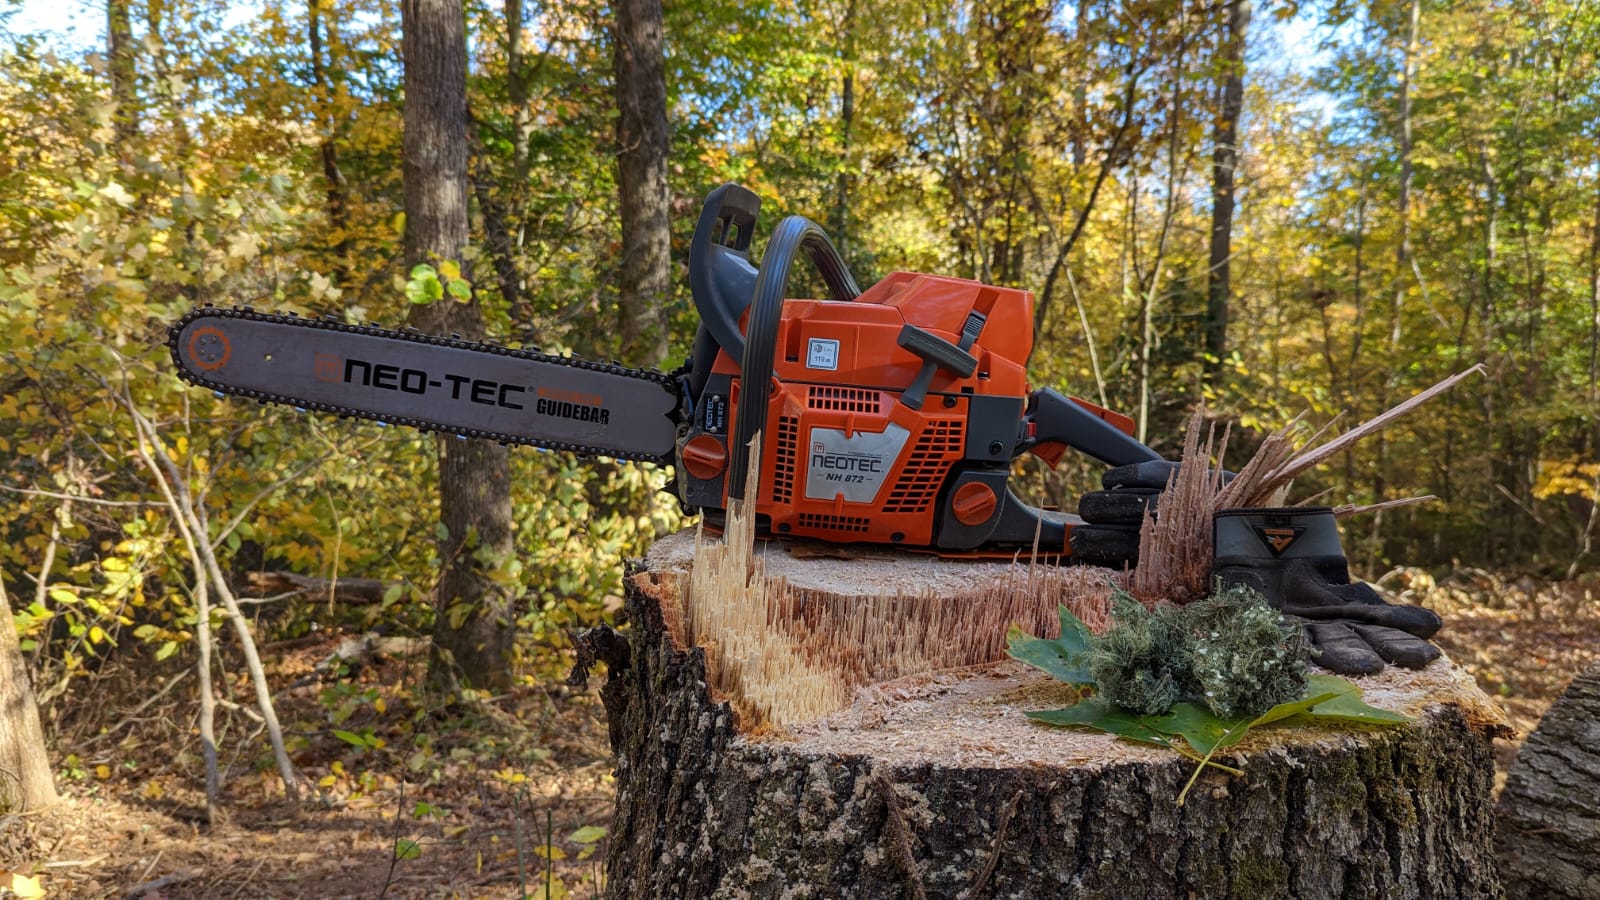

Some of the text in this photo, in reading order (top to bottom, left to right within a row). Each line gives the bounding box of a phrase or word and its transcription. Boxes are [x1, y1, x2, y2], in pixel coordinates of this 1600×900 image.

[344, 359, 526, 410] NEO-TEC
[537, 398, 609, 425] GUIDEBAR
[813, 455, 882, 473] NEOTEC
[845, 474, 864, 484] 872
